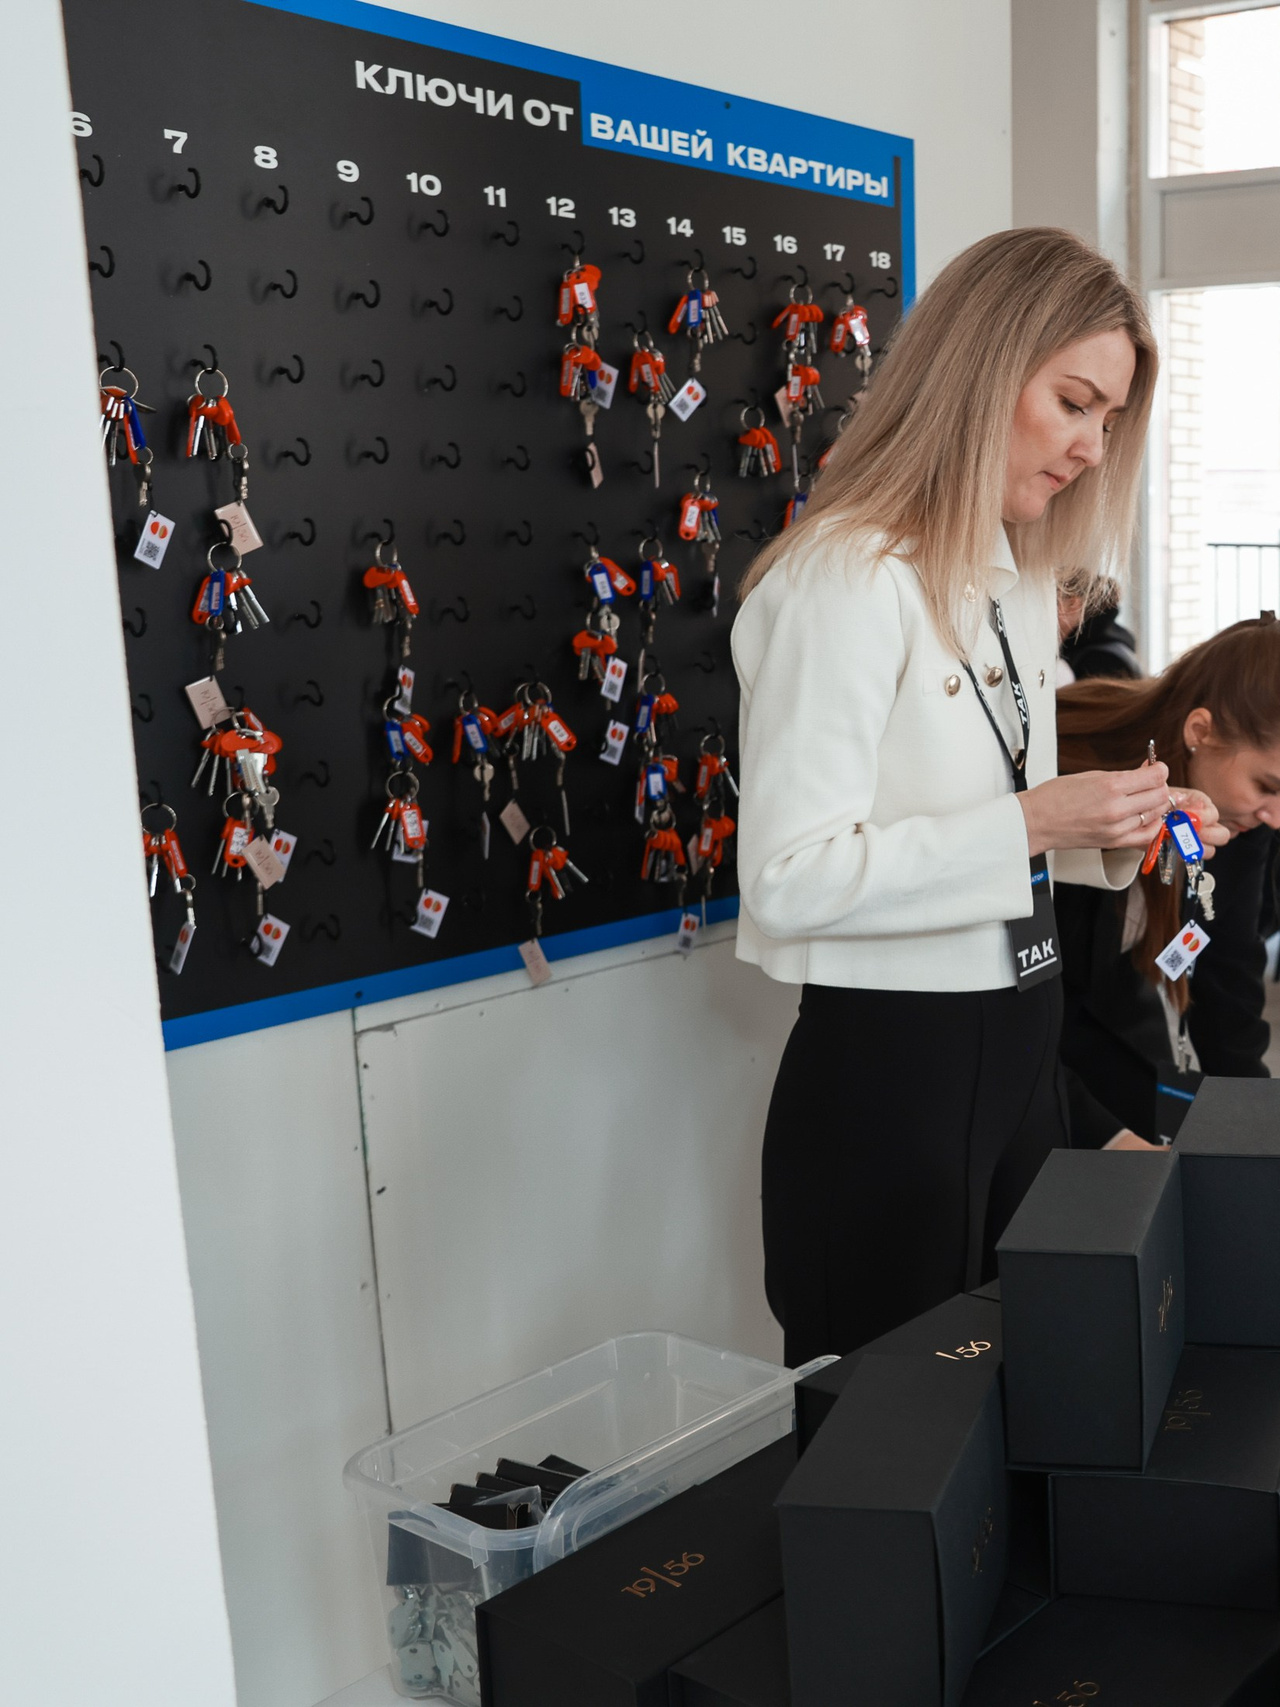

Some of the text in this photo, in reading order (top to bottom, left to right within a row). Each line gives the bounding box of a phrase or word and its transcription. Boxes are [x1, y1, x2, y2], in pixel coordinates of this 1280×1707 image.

[355, 60, 888, 198] КЛЮЧИ ОТ ВАШЕЙ КВАРТИРЫ
[70, 111, 891, 269] 6 7 8 9 10 11 12 13 14 15 16 17 18
[1181, 832, 1193, 850] 705
[1017, 937, 1055, 969] ТАК
